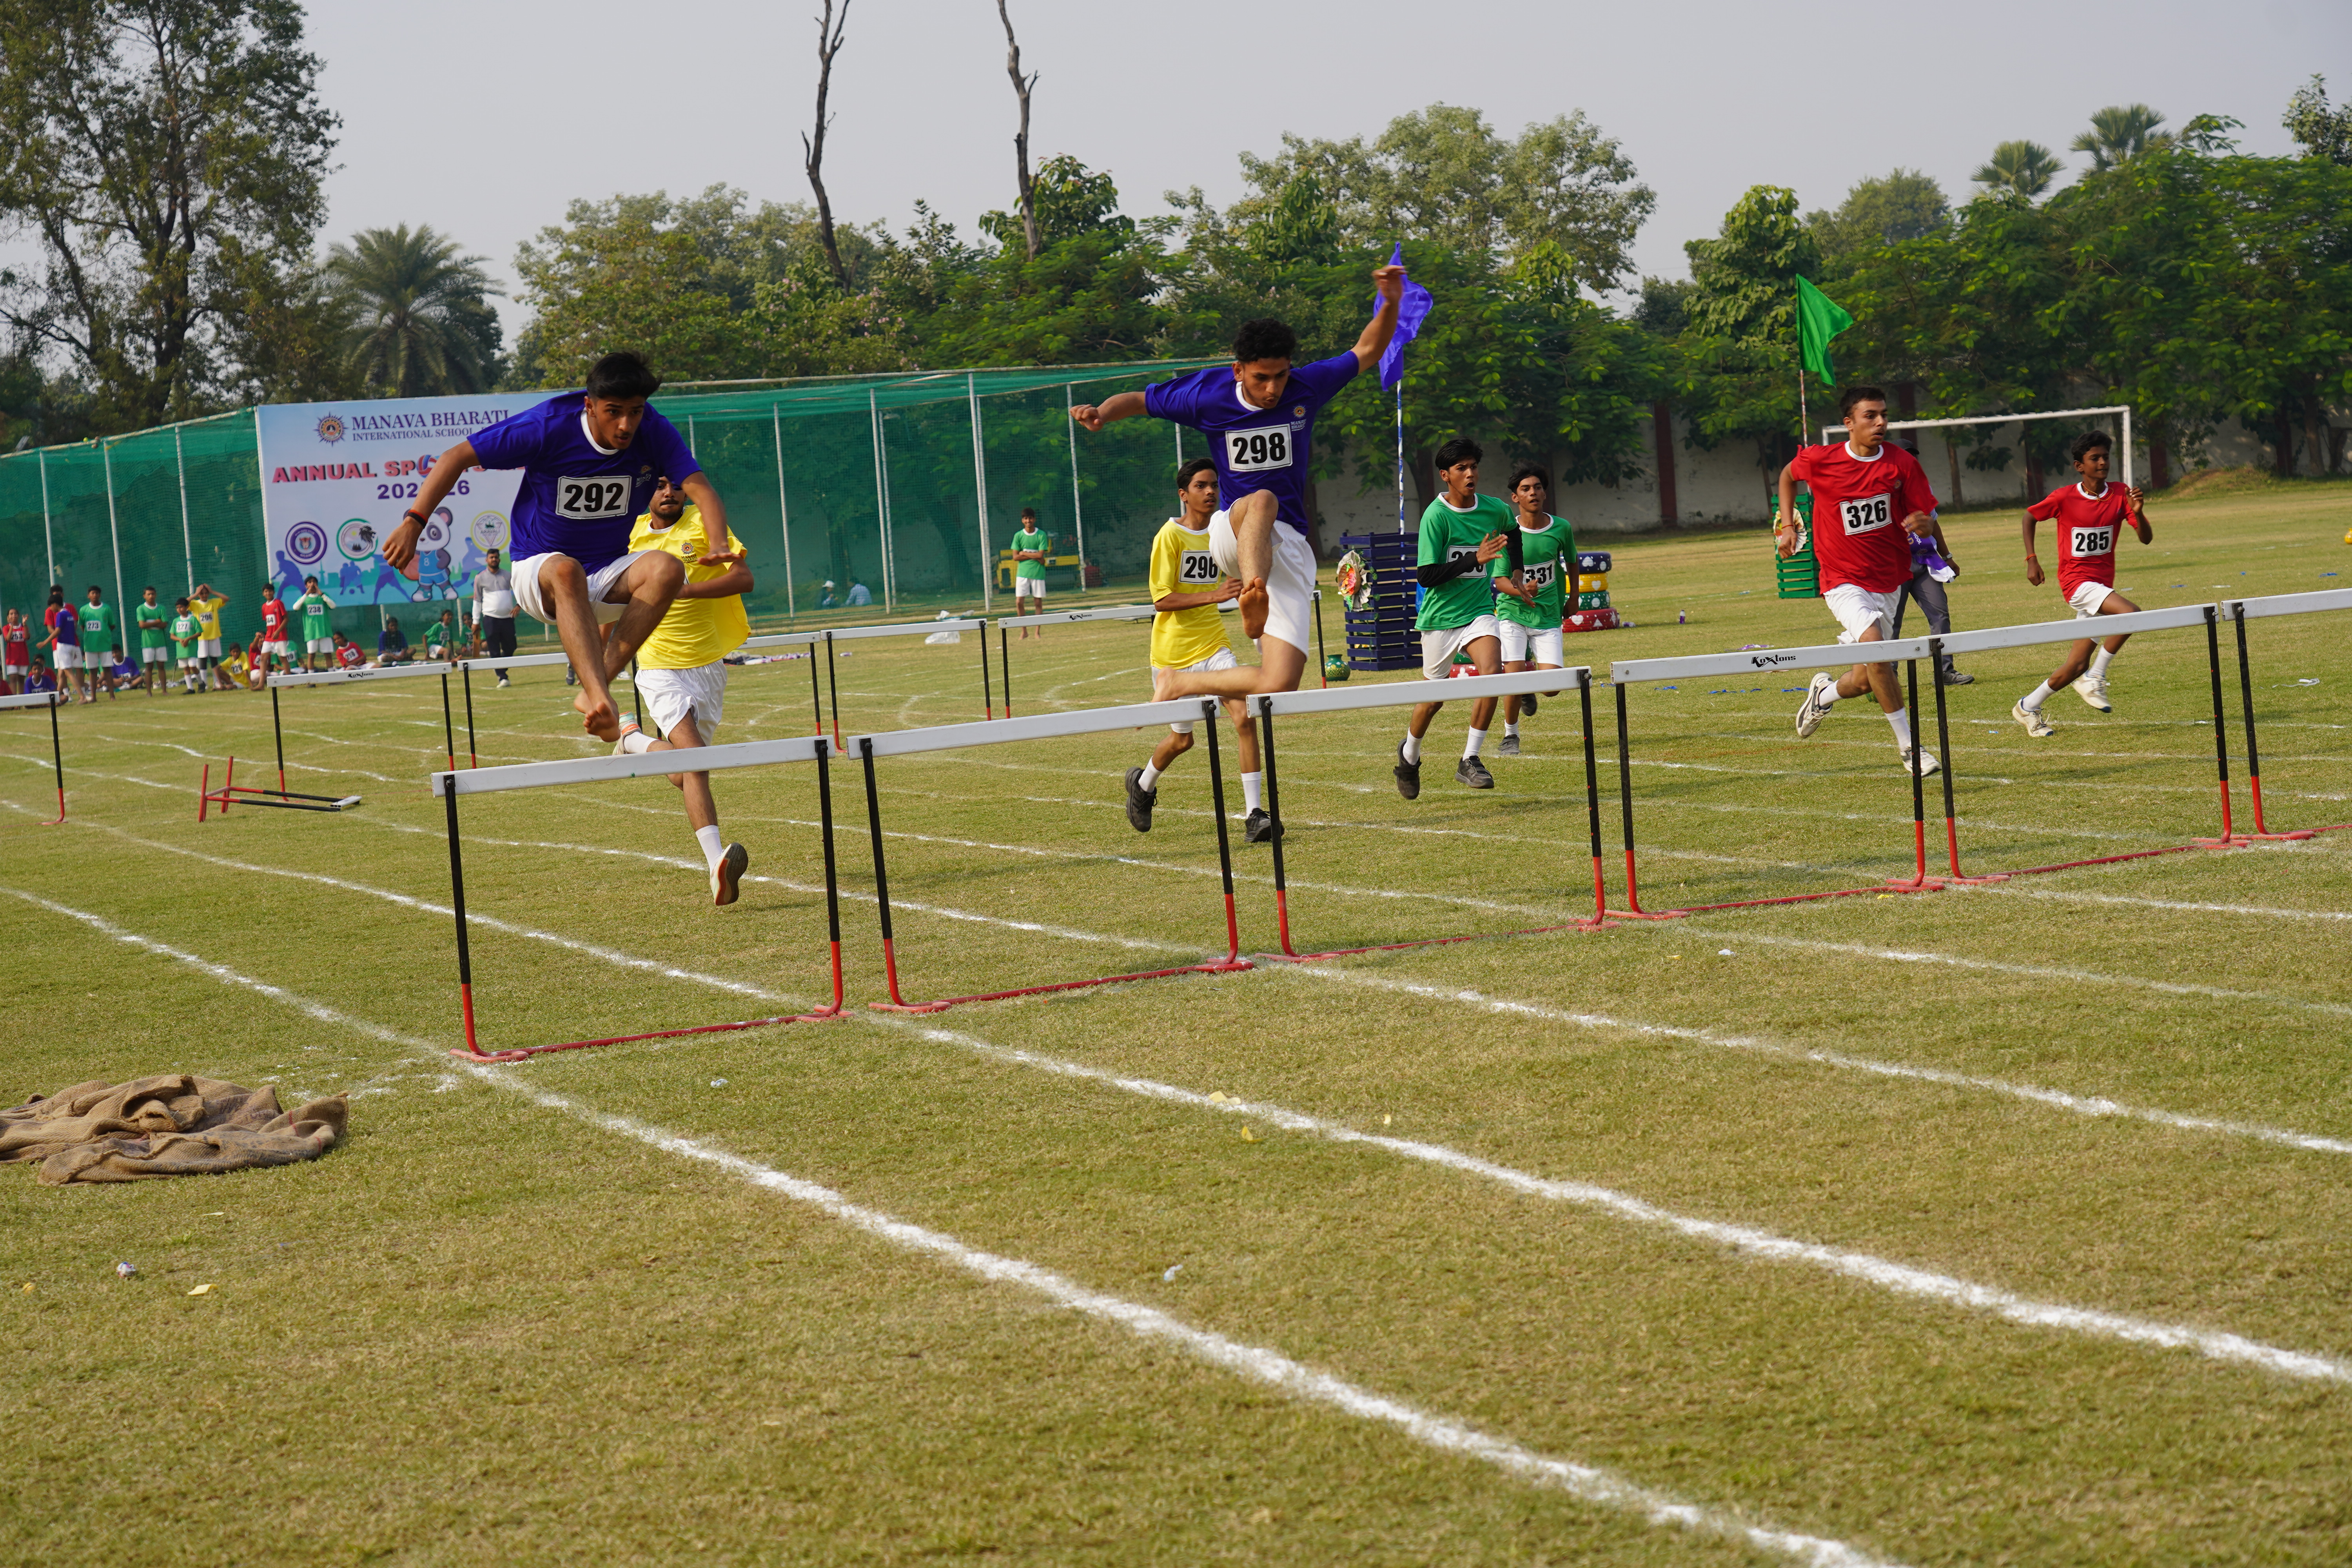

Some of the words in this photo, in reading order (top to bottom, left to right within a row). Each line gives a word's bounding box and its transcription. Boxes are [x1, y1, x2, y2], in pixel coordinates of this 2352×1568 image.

[352, 414, 427, 430] MANAVA
[431, 410, 509, 426] BHARATI
[353, 429, 433, 441] INTERNATIONAL
[435, 427, 475, 438] SCHOOL
[1233, 432, 1285, 464] 298
[272, 462, 377, 483] ANNUAL
[564, 483, 624, 512] 292
[1847, 500, 1887, 528] 326
[2075, 531, 2109, 552] 285
[424, 557, 430, 566] 8
[1184, 556, 1218, 579] 296
[1526, 564, 1552, 584] 331
